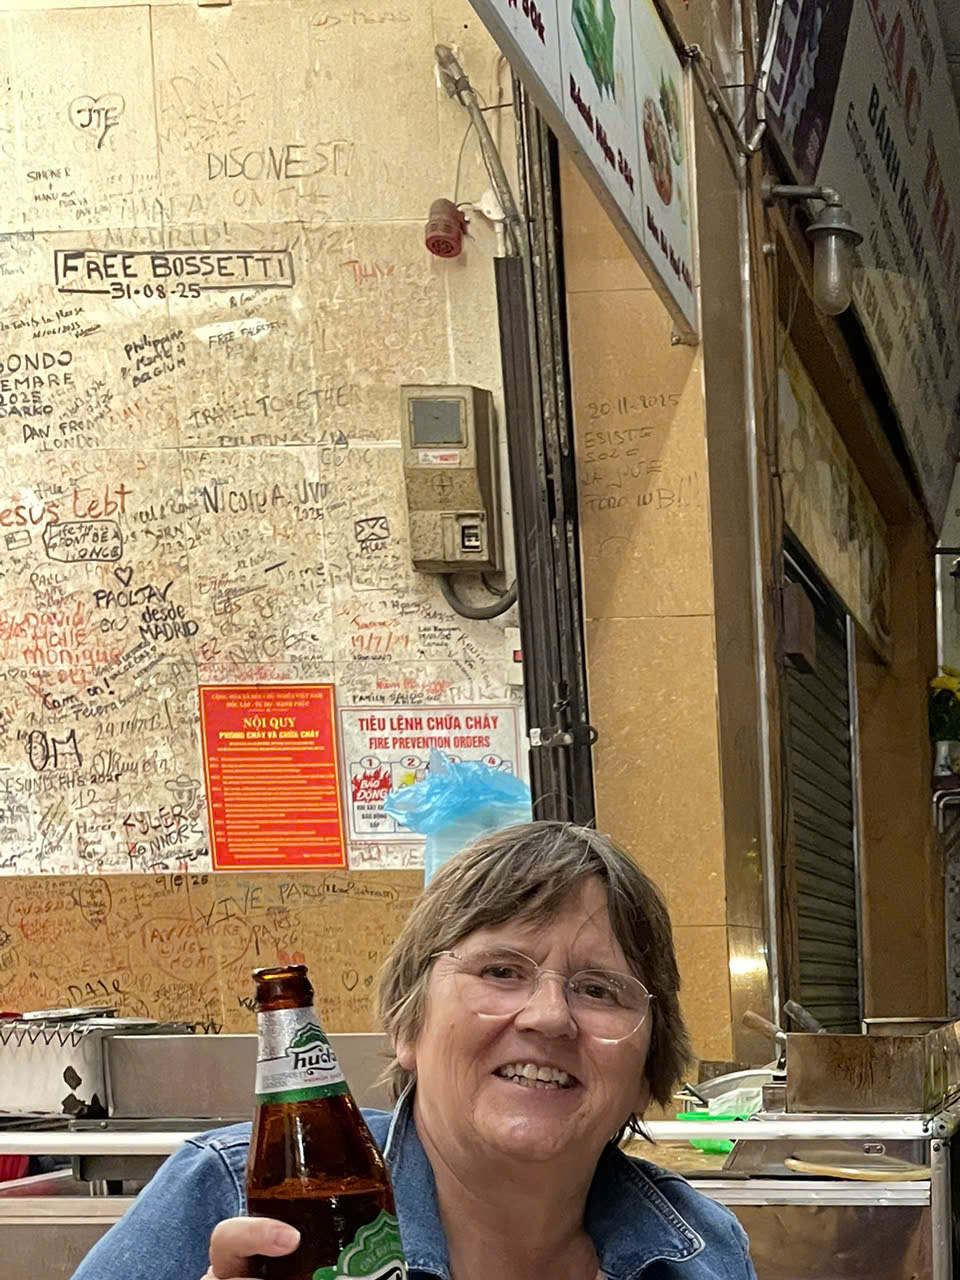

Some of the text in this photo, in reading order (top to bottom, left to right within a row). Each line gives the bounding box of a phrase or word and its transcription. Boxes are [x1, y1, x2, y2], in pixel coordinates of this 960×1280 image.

[63, 252, 285, 280] FREE BOSSETTI
[141, 600, 186, 624] desde
[139, 620, 199, 643] MADRID
[243, 714, 297, 731] NỘI QUY
[358, 712, 499, 734] TIÊU LỆNH CHỮA CHÁY
[369, 735, 491, 749] FIRE PREVENTION ORDERS
[367, 758, 374, 767] 1
[407, 758, 415, 767] 2
[360, 778, 380, 790] BÁO
